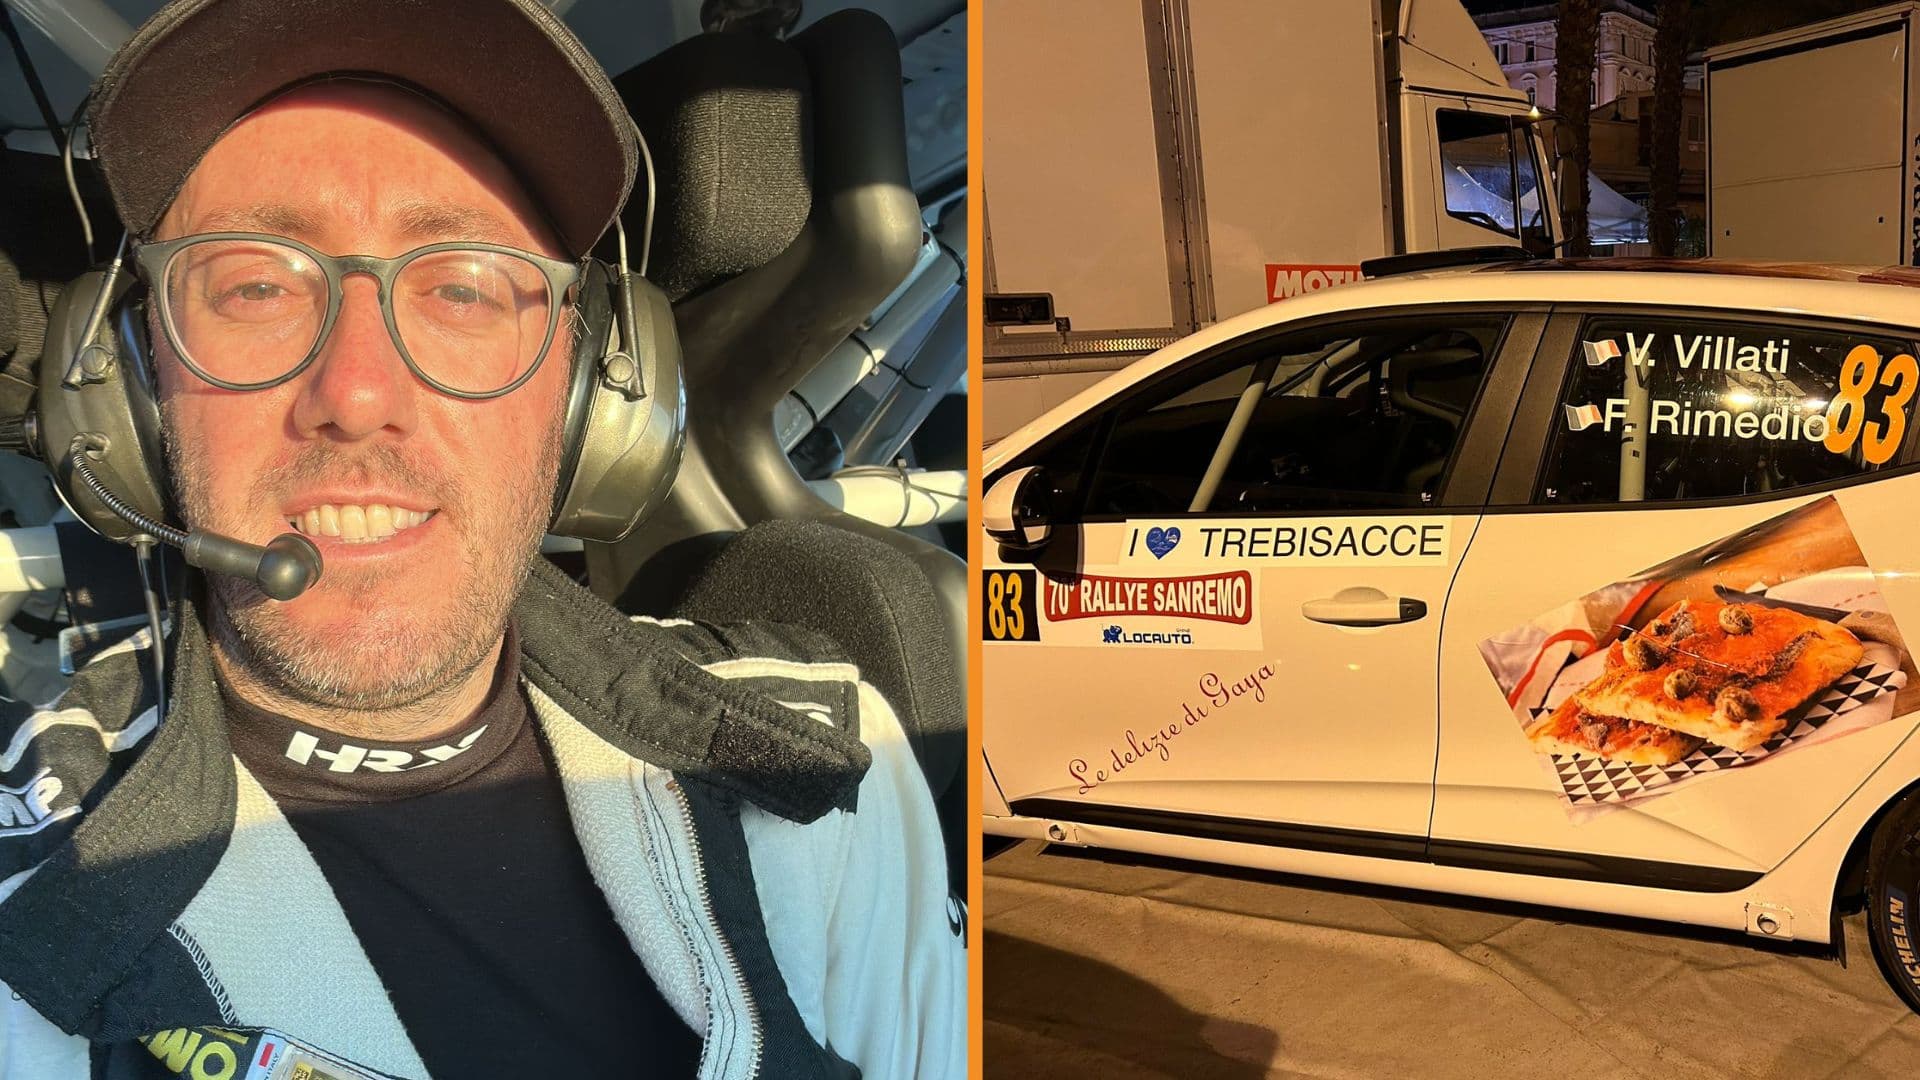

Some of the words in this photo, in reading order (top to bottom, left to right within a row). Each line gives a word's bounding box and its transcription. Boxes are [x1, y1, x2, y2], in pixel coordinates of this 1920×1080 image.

[1626, 332, 1655, 367] V.
[1673, 334, 1790, 374] Villati
[1603, 398, 1632, 432] F.
[1650, 400, 1830, 442] Rimedio
[1823, 344, 1919, 465] 83
[1128, 528, 1139, 557] I
[1200, 525, 1444, 557] TREBISACCE
[988, 572, 1024, 639] 83
[1080, 579, 1148, 612] RALLYE
[1153, 576, 1246, 618] SANREMO
[1123, 633, 1191, 644] LOCAUTO
[1069, 759, 1109, 794] Le
[1112, 730, 1182, 772] delizie
[1182, 702, 1209, 725] di
[1200, 664, 1276, 708] Gaya
[1890, 897, 1920, 990] ICHELIN
[137, 1027, 238, 1080] OM
